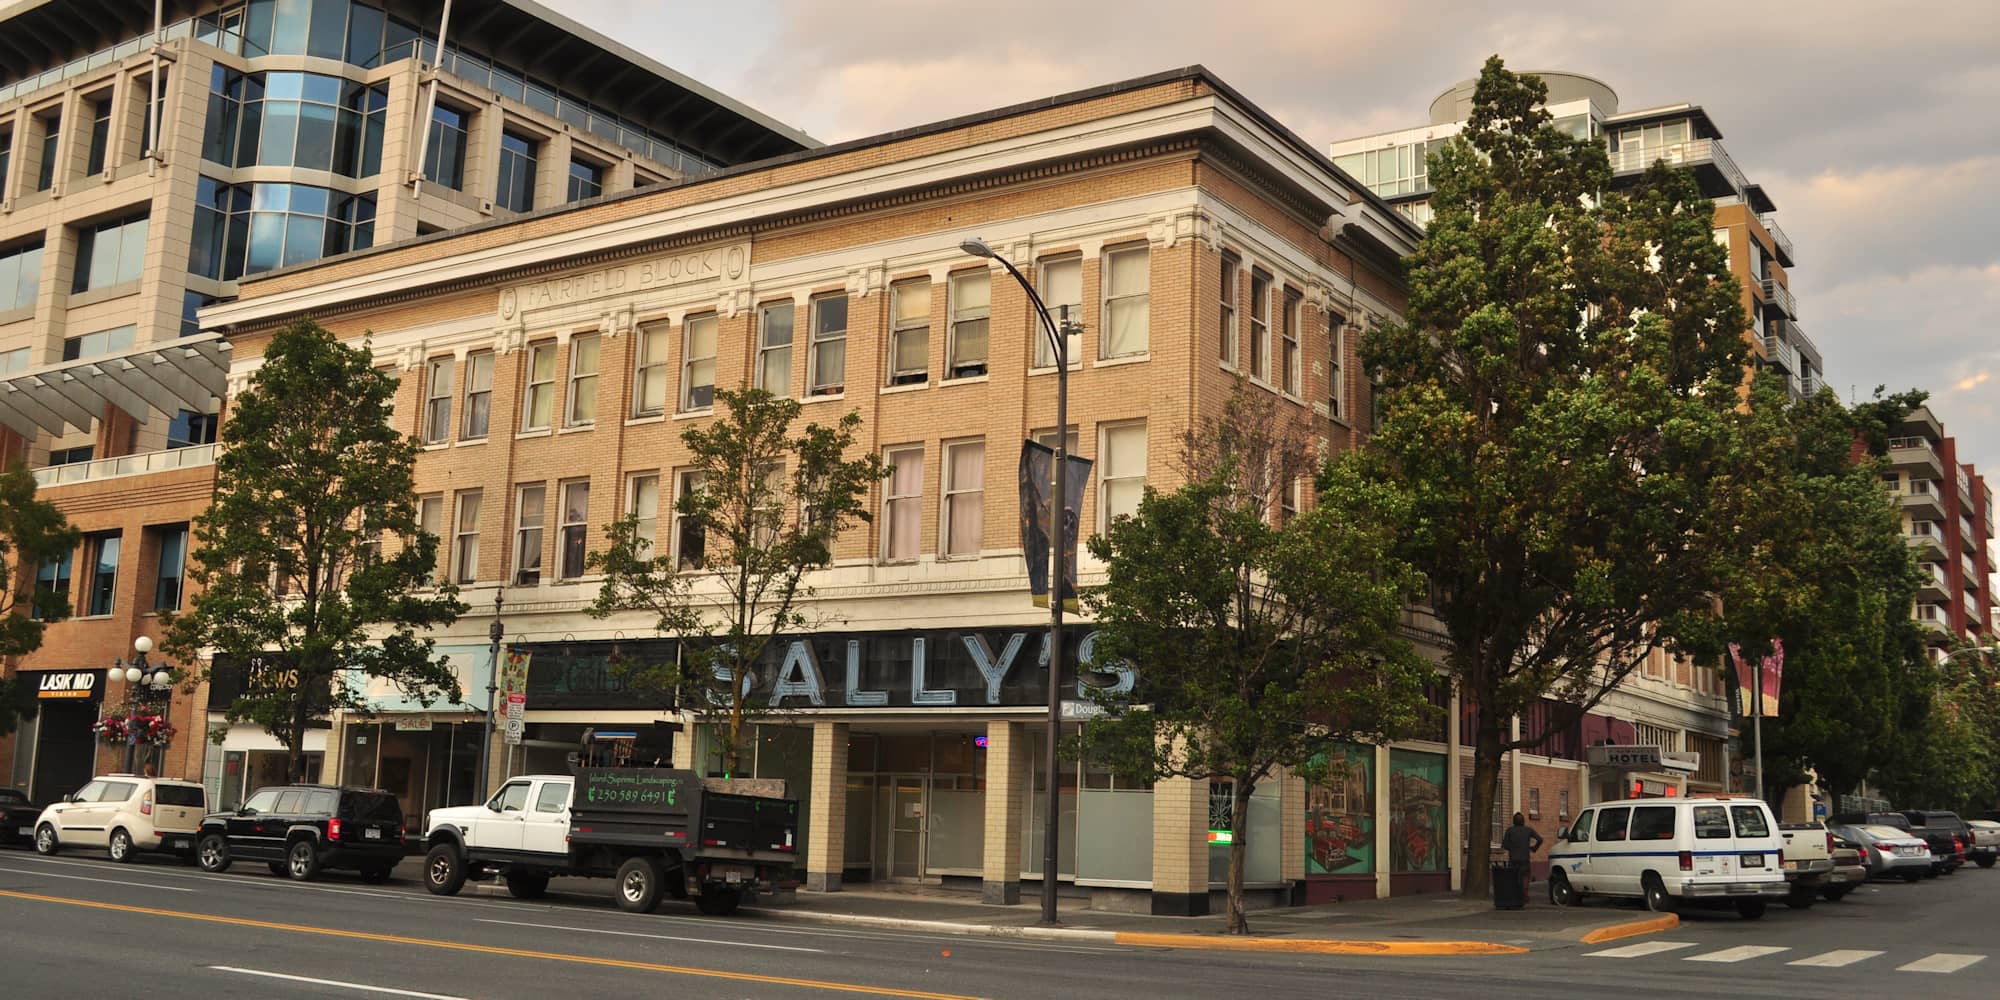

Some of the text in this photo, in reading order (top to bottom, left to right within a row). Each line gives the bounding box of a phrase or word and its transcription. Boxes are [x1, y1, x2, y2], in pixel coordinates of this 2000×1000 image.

[528, 253, 713, 304] FAIRFIELD BLOCK
[706, 631, 1136, 707] SALLY'S
[40, 673, 95, 691] LASIK MD
[1609, 754, 1658, 763] HOTEL
[619, 790, 639, 803] 589
